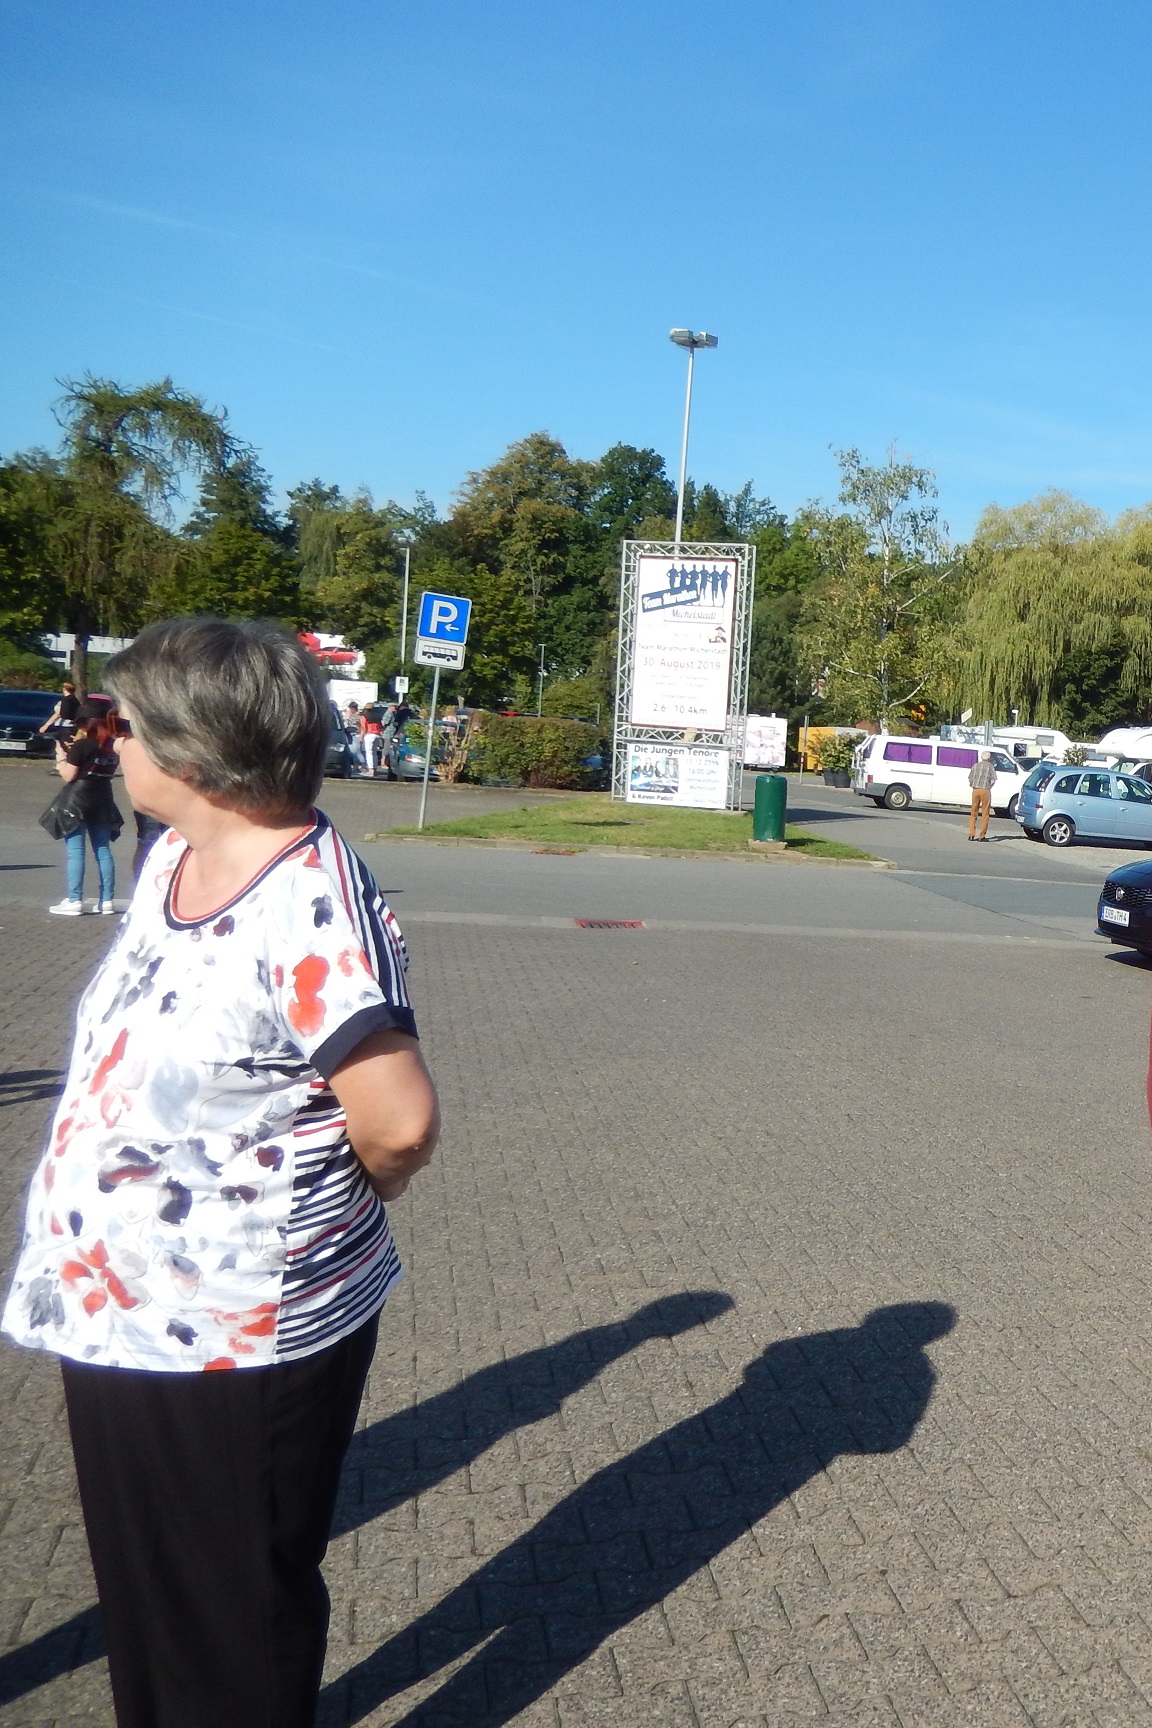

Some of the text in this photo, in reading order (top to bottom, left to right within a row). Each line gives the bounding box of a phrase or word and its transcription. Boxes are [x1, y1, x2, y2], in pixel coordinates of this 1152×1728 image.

[643, 597, 662, 609] Team
[429, 600, 458, 634] P
[671, 608, 717, 620] Michelstadt
[659, 658, 694, 670] August
[697, 660, 721, 670] 2019
[634, 744, 649, 754] Die
[650, 746, 685, 757] Jungen
